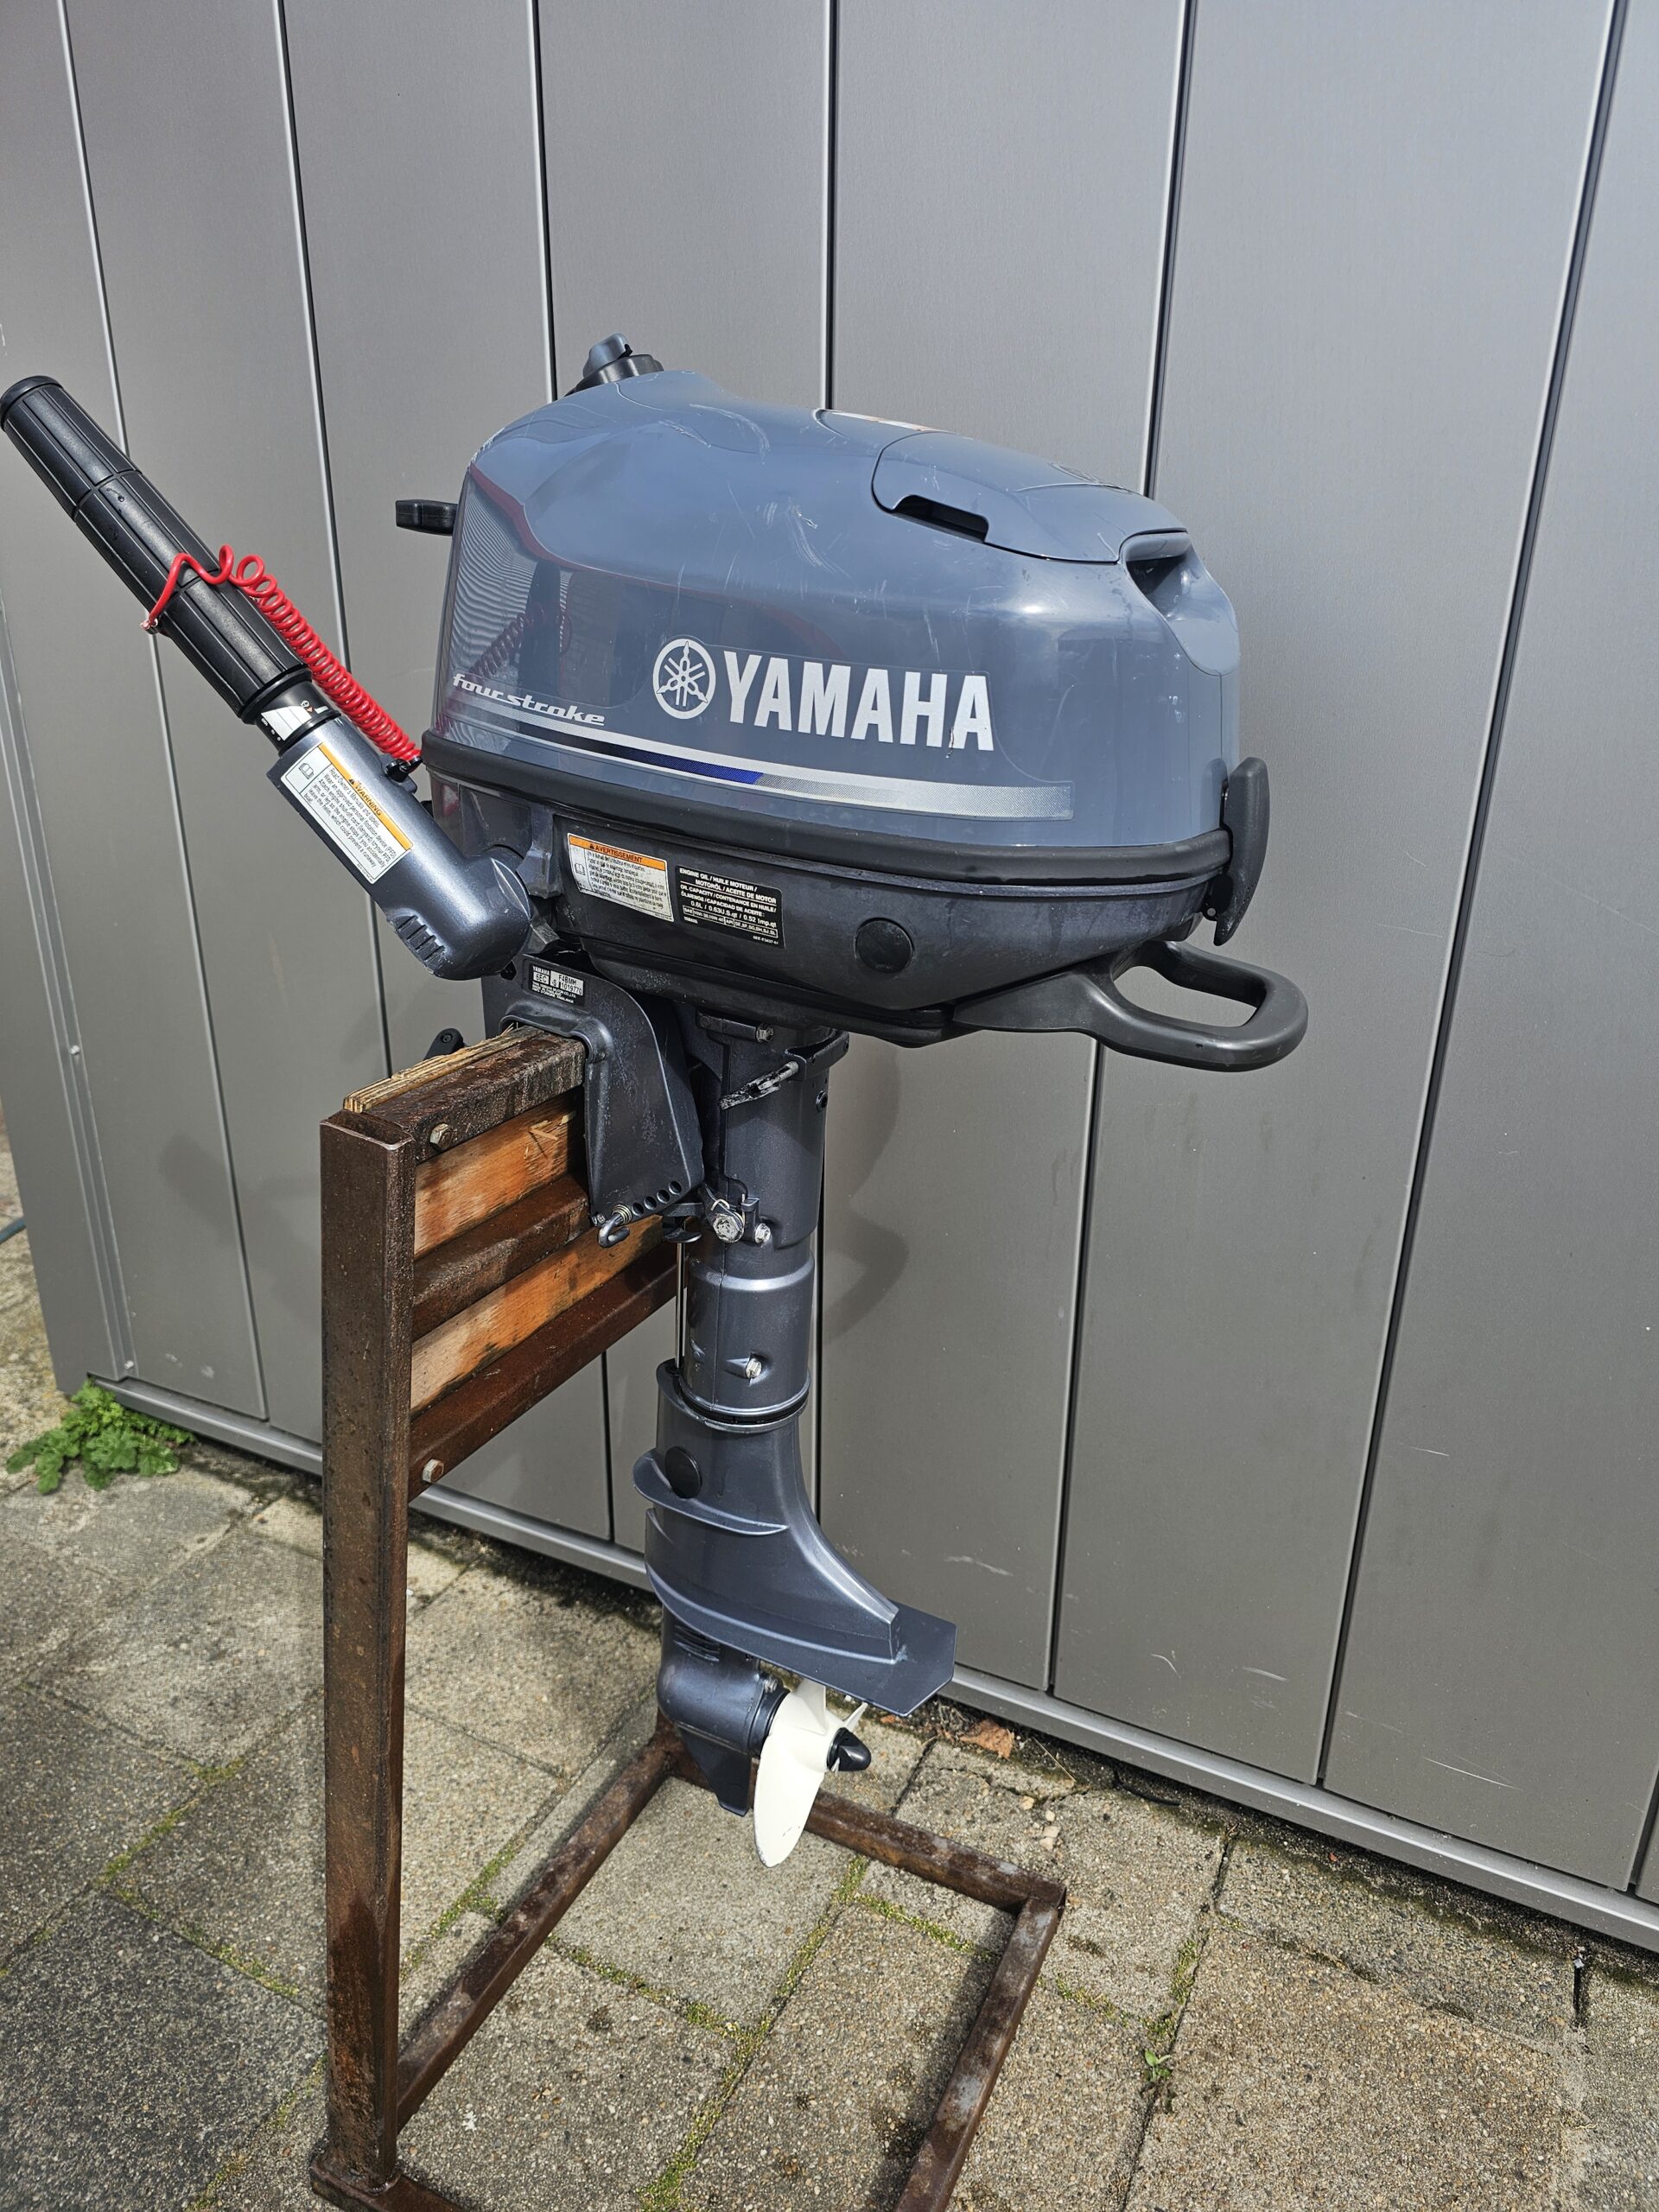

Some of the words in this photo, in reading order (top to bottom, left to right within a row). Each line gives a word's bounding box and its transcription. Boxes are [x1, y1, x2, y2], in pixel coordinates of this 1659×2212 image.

[724, 651, 994, 751] YAMAHA
[328, 767, 340, 779] Read
[594, 843, 643, 864] AVERTISSEMENT
[679, 868, 699, 878] ENGINE
[712, 876, 729, 885] HUILE
[729, 880, 753, 891] MOTEUR
[689, 887, 713, 897] CAPACITY
[715, 893, 749, 906] CONTENANCE
[725, 887, 746, 897] ACEITE
[755, 893, 776, 904] MOTOR
[706, 898, 735, 910] CAPACIDAD
[742, 913, 756, 923] 0.52
[532, 965, 550, 976] YAMAHA
[536, 973, 546, 982] 6EC
[558, 974, 576, 985] F4BMH
